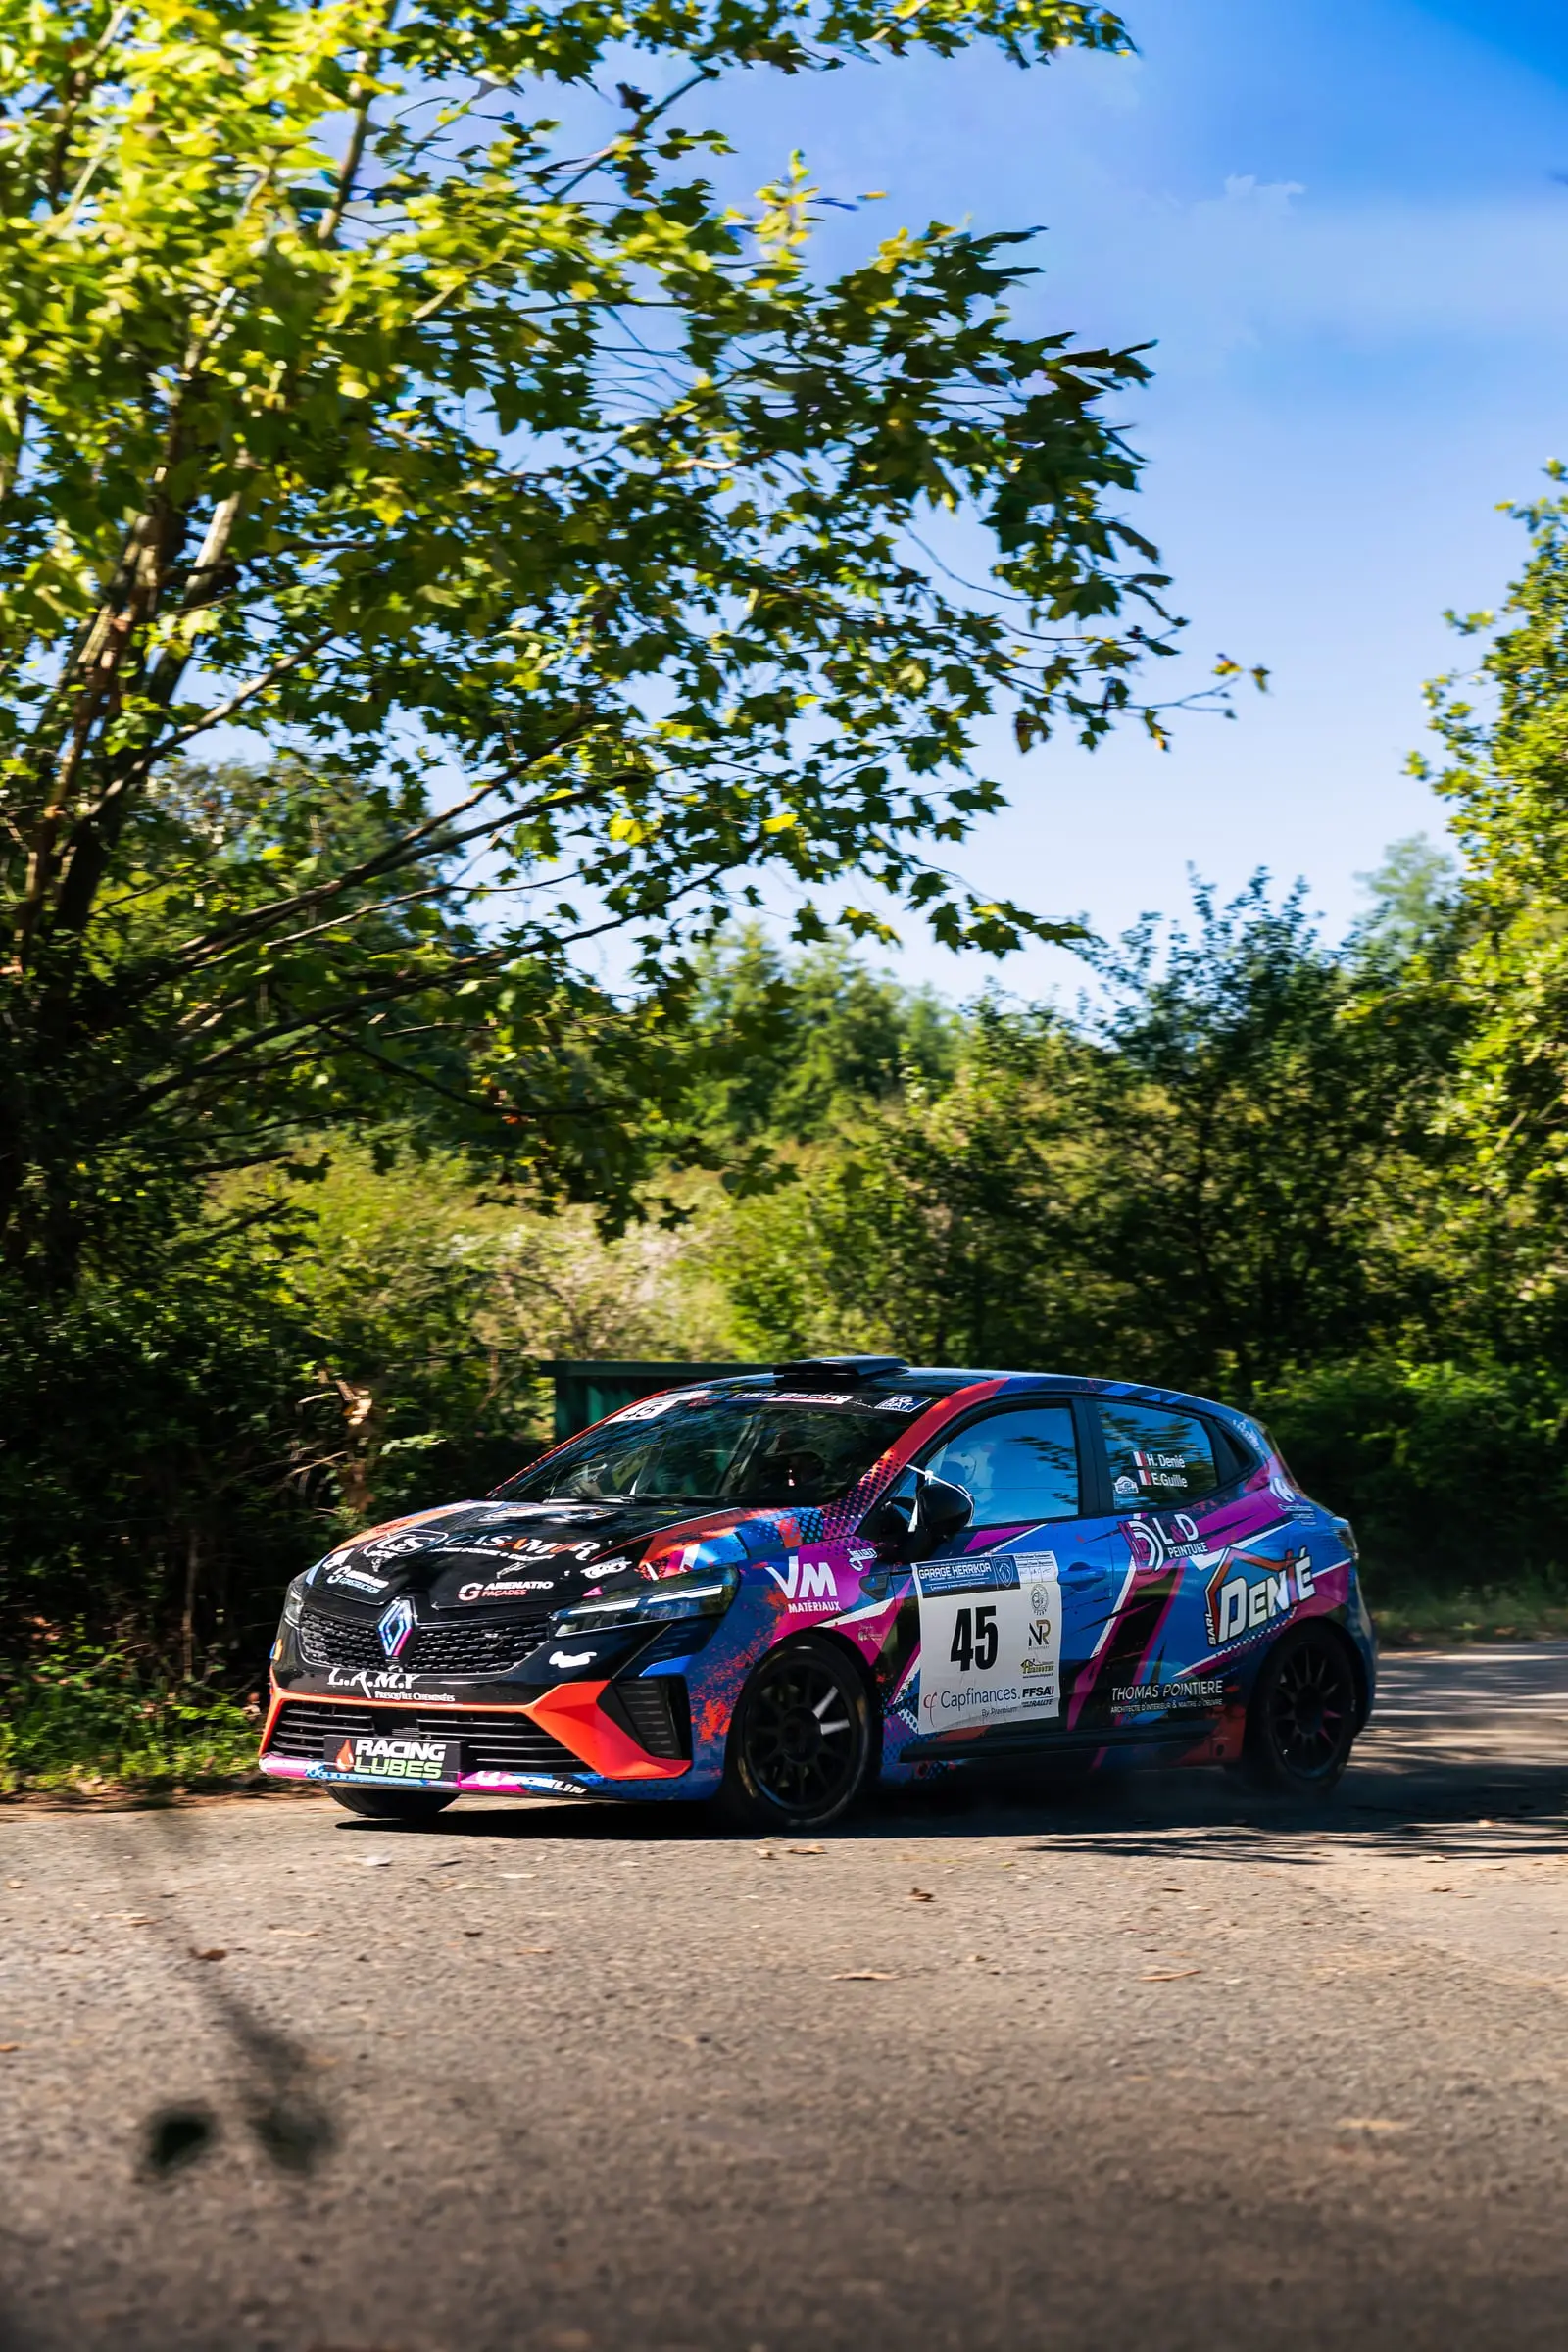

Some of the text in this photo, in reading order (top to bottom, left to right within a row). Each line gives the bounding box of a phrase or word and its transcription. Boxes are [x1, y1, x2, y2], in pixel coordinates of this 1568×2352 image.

[1146, 1453, 1186, 1468] H. Denié
[1168, 1542, 1209, 1559] PEINTURE
[764, 1555, 838, 1599] VM
[918, 1566, 951, 1580] GARAGE
[480, 1589, 528, 1597] FAÇADES
[787, 1600, 842, 1614] MATÉRIAUX
[950, 1605, 999, 1672] 45
[1111, 1680, 1224, 1701] THOMAS POINTIERE
[981, 1705, 1018, 1718] By Premium
[355, 1739, 446, 1761] RACING
[353, 1756, 444, 1779] LUBES
